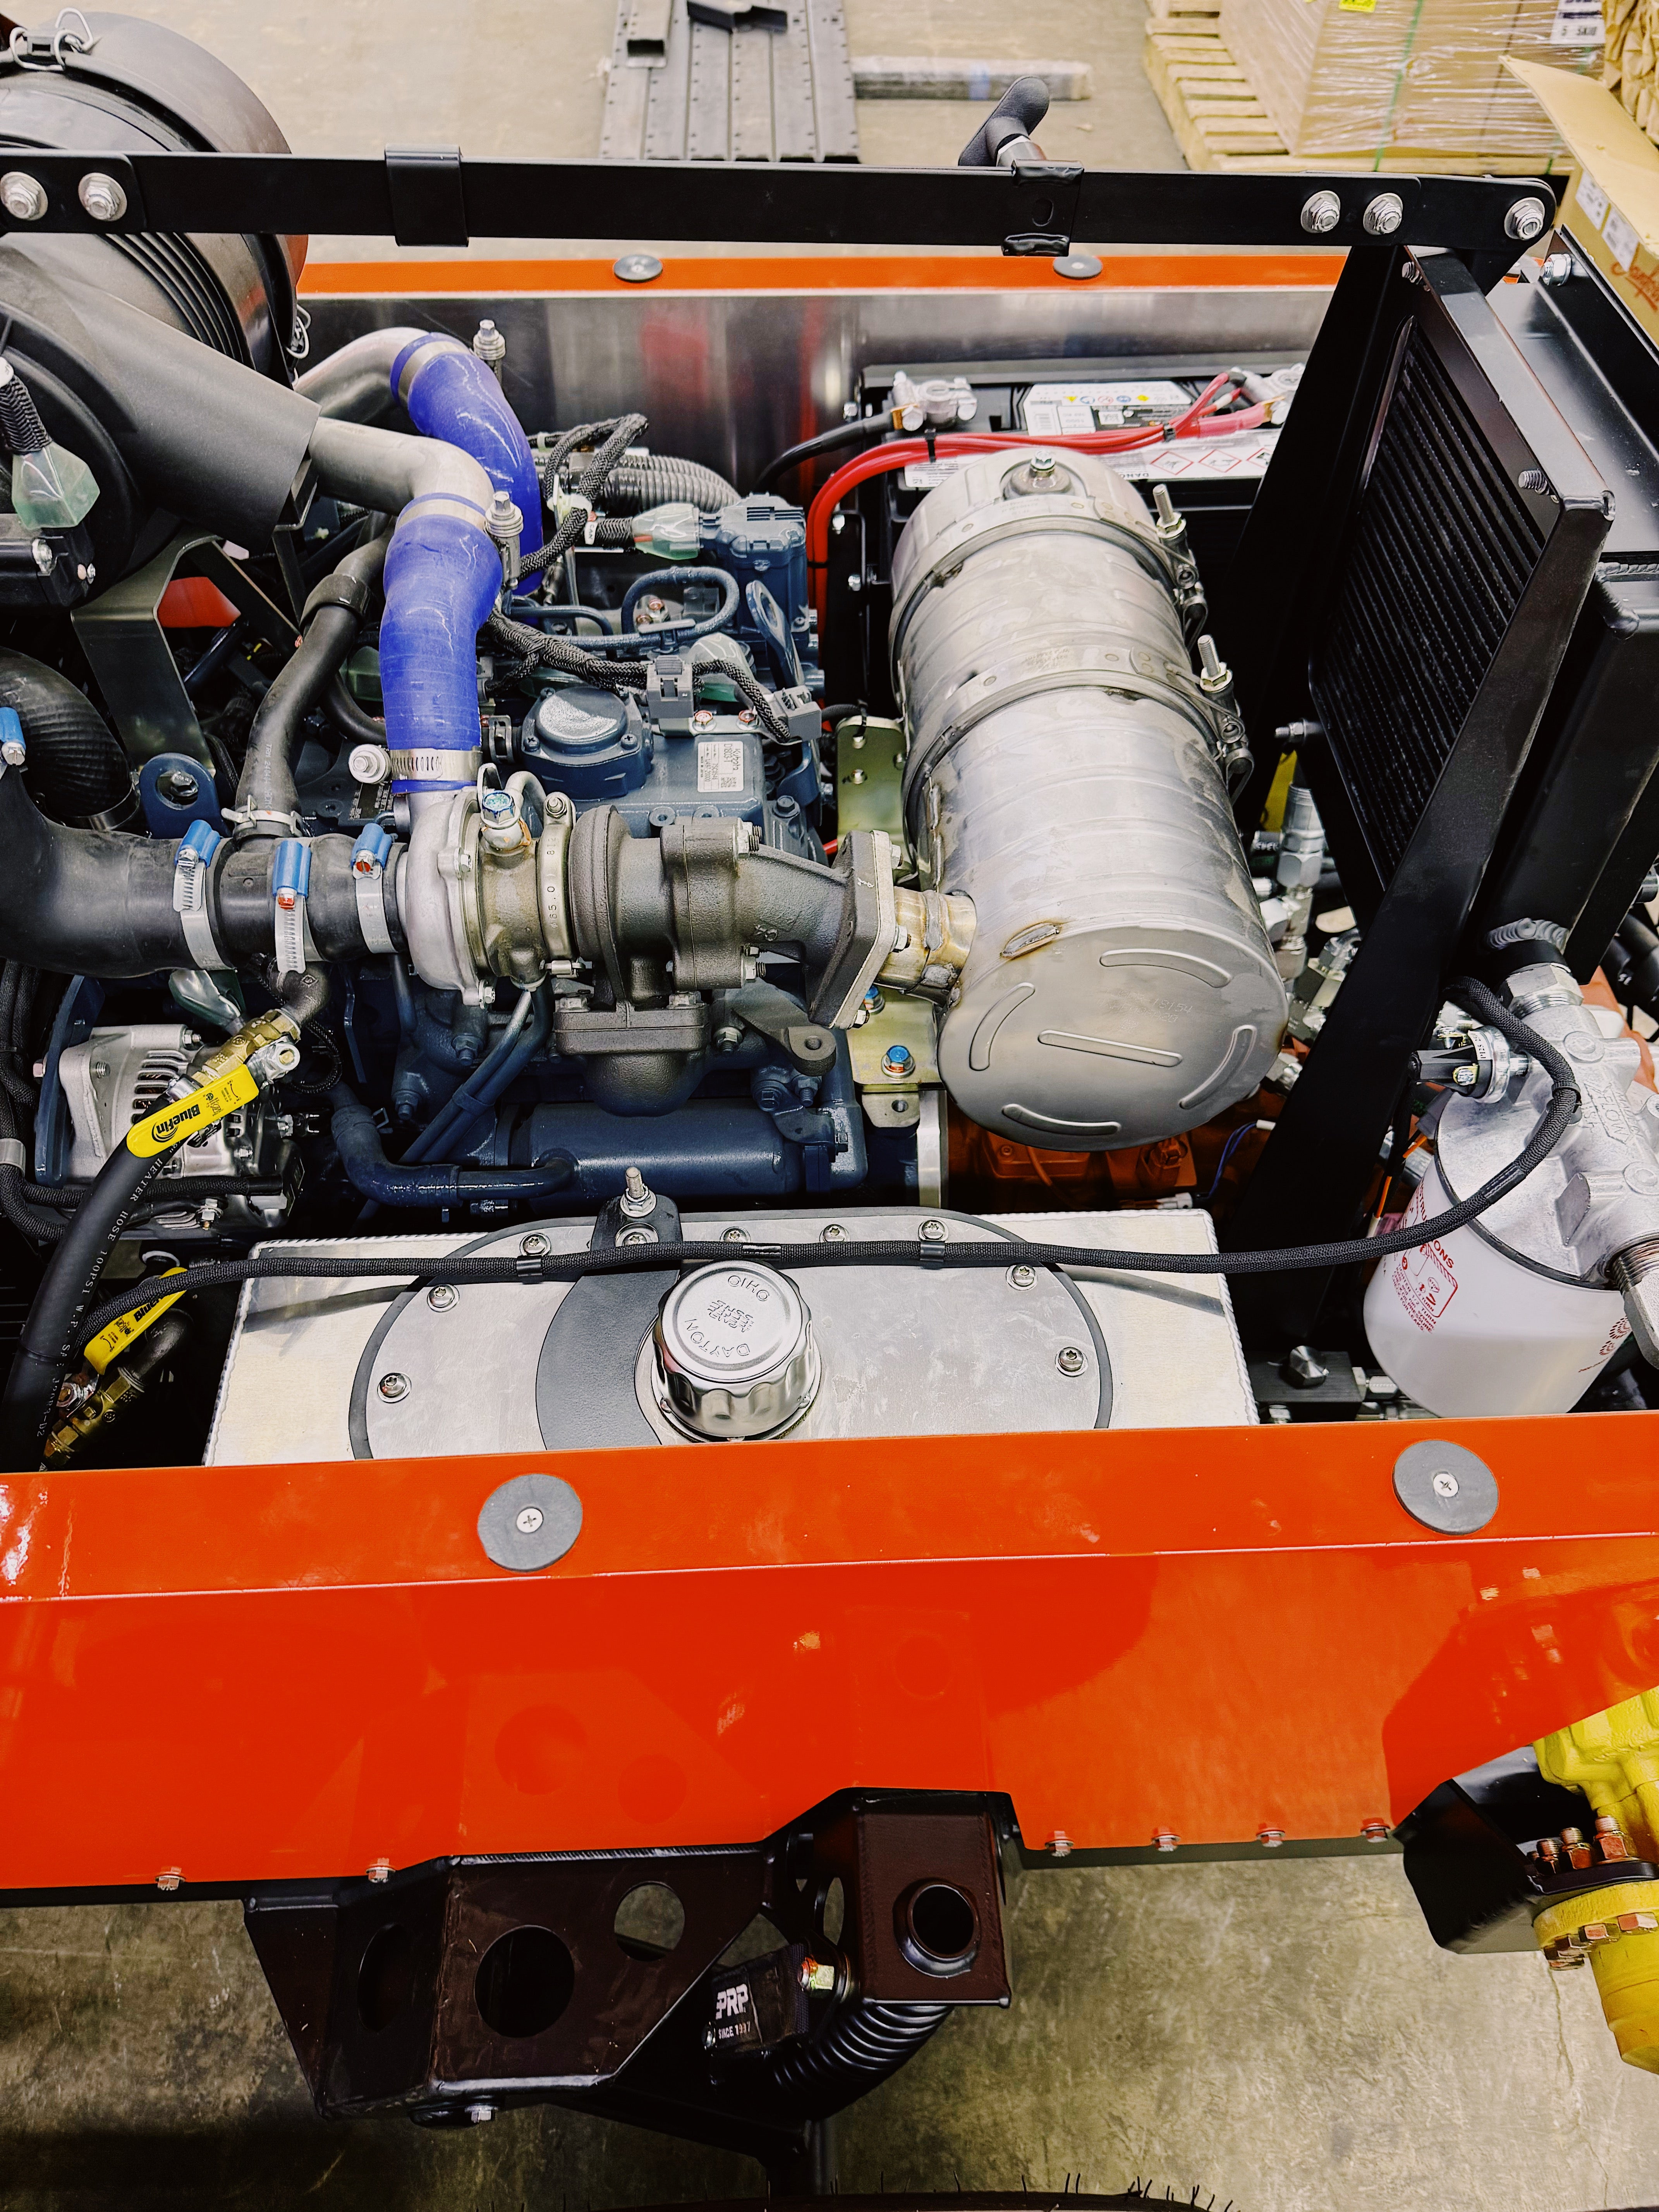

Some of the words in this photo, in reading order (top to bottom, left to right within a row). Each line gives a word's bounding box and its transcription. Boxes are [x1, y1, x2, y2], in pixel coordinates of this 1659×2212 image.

[733, 748, 741, 771] Kubota
[130, 1158, 164, 1202] HEATER
[107, 1210, 129, 1242] HOSE
[82, 1250, 108, 1294] 100PSI
[728, 1275, 770, 1302] OHIO
[1421, 1307, 1436, 1324] TURN
[1422, 1297, 1434, 1312] TURN
[684, 1319, 750, 1357] DAYTON
[715, 1983, 749, 2020] PRP
[718, 2025, 735, 2040] SINCE
